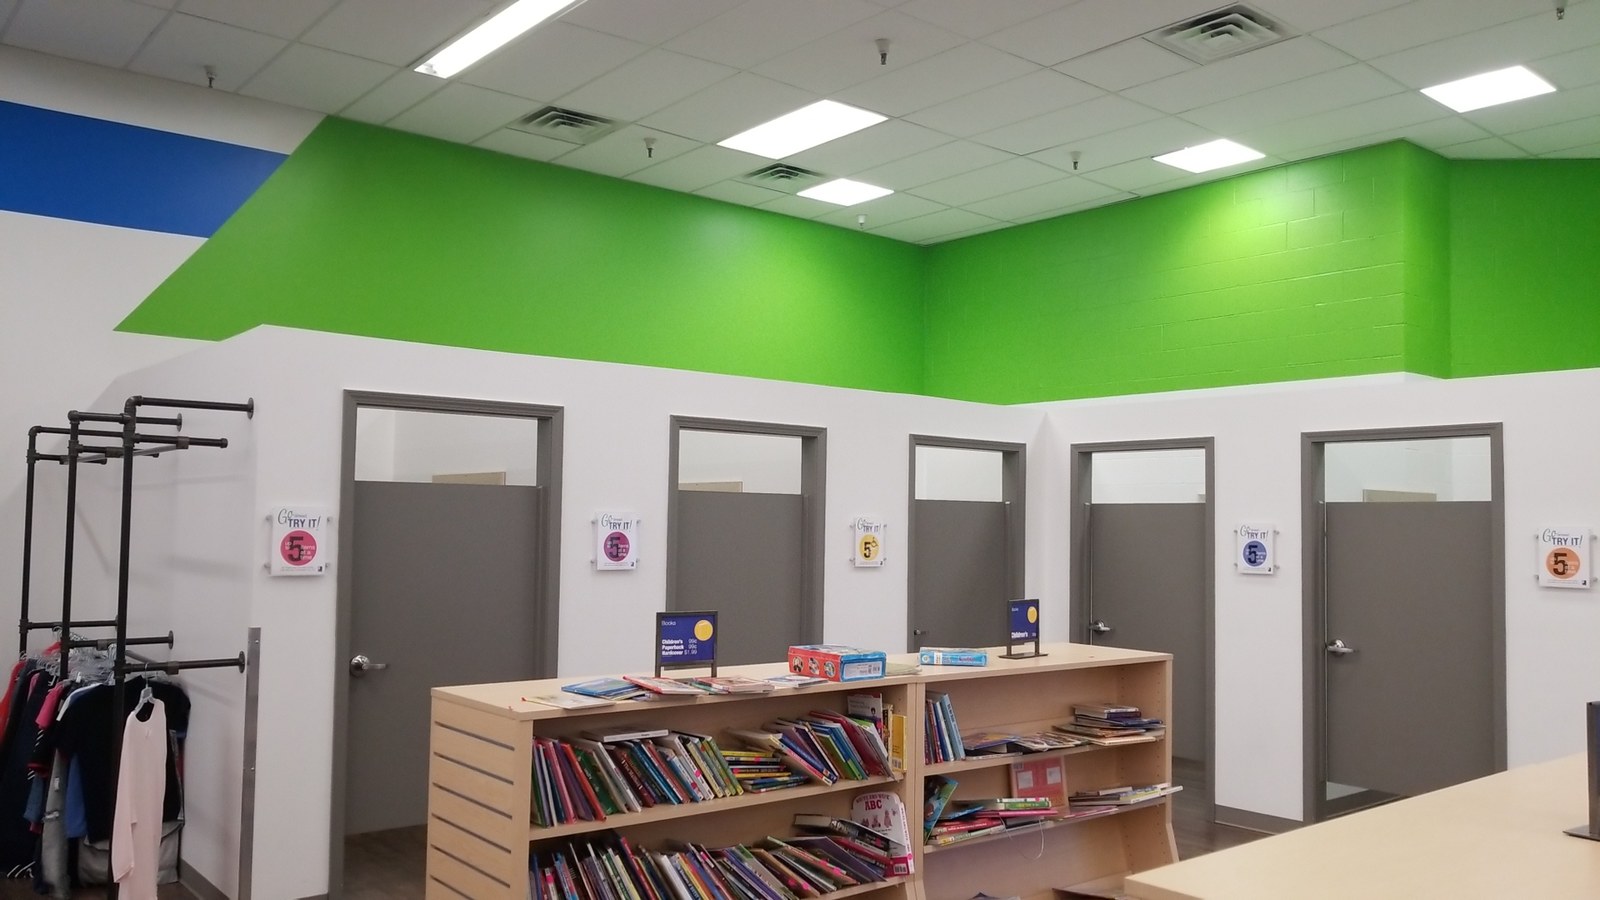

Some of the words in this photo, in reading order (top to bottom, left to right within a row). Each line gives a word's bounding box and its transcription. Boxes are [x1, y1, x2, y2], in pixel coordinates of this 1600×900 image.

[278, 508, 293, 524] Go
[288, 518, 306, 528] TRY
[308, 516, 321, 530] IT!
[610, 522, 622, 530] TRY
[1247, 531, 1258, 539] TRY
[1552, 537, 1568, 546] TRY
[288, 536, 304, 562] 5
[608, 536, 620, 558] 5
[864, 541, 872, 558] 5
[1248, 544, 1258, 564] 5
[1552, 552, 1568, 576] 5
[864, 800, 882, 810] ABC
